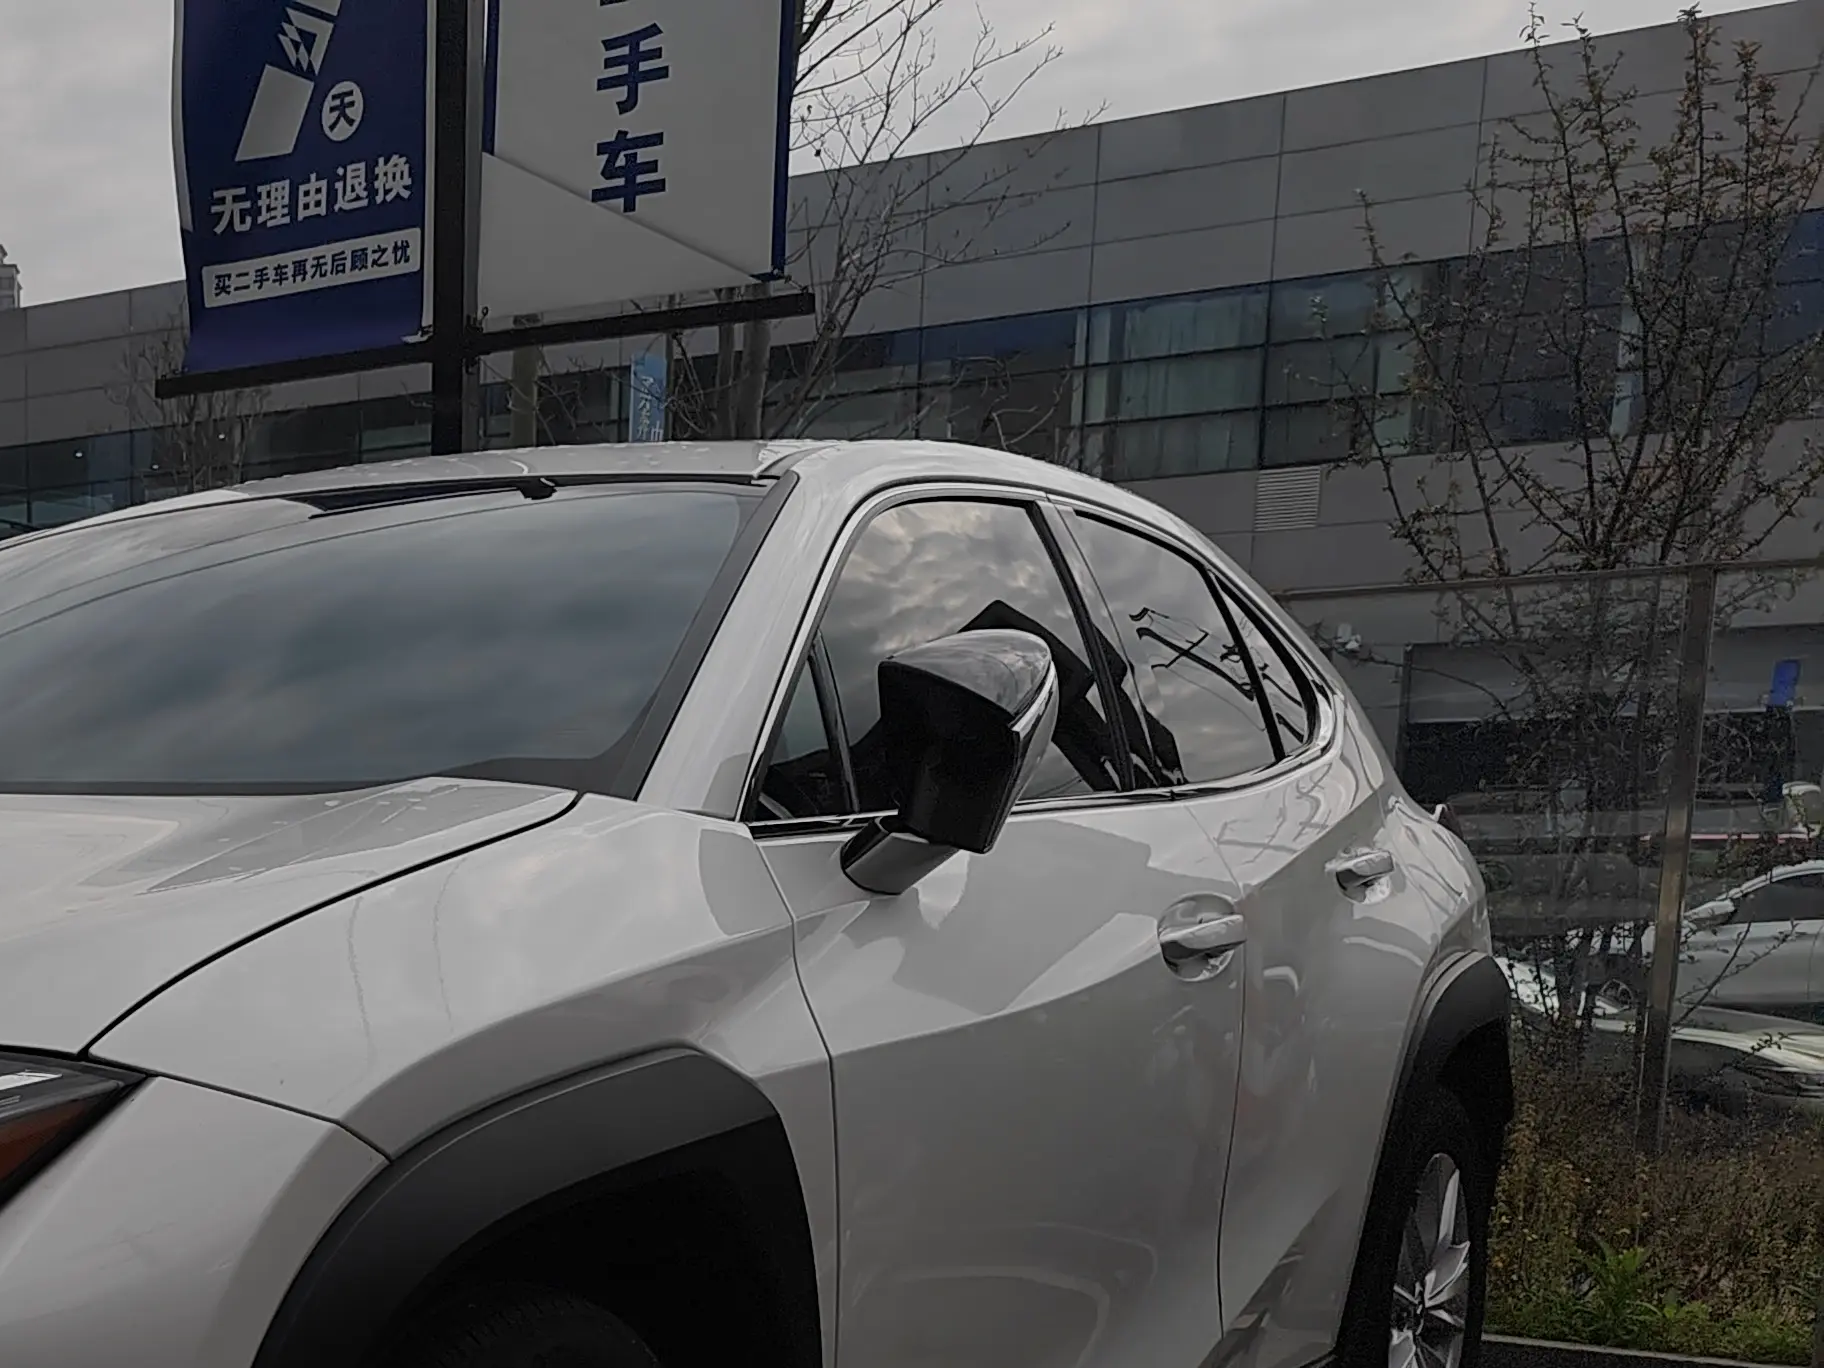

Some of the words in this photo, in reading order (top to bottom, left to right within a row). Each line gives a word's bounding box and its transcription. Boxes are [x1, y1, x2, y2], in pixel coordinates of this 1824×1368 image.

[328, 89, 356, 132] 天
[591, 0, 669, 213] 手车
[210, 153, 413, 235] 无理由退换
[214, 240, 411, 297] 买二手车再无后顾之忧
